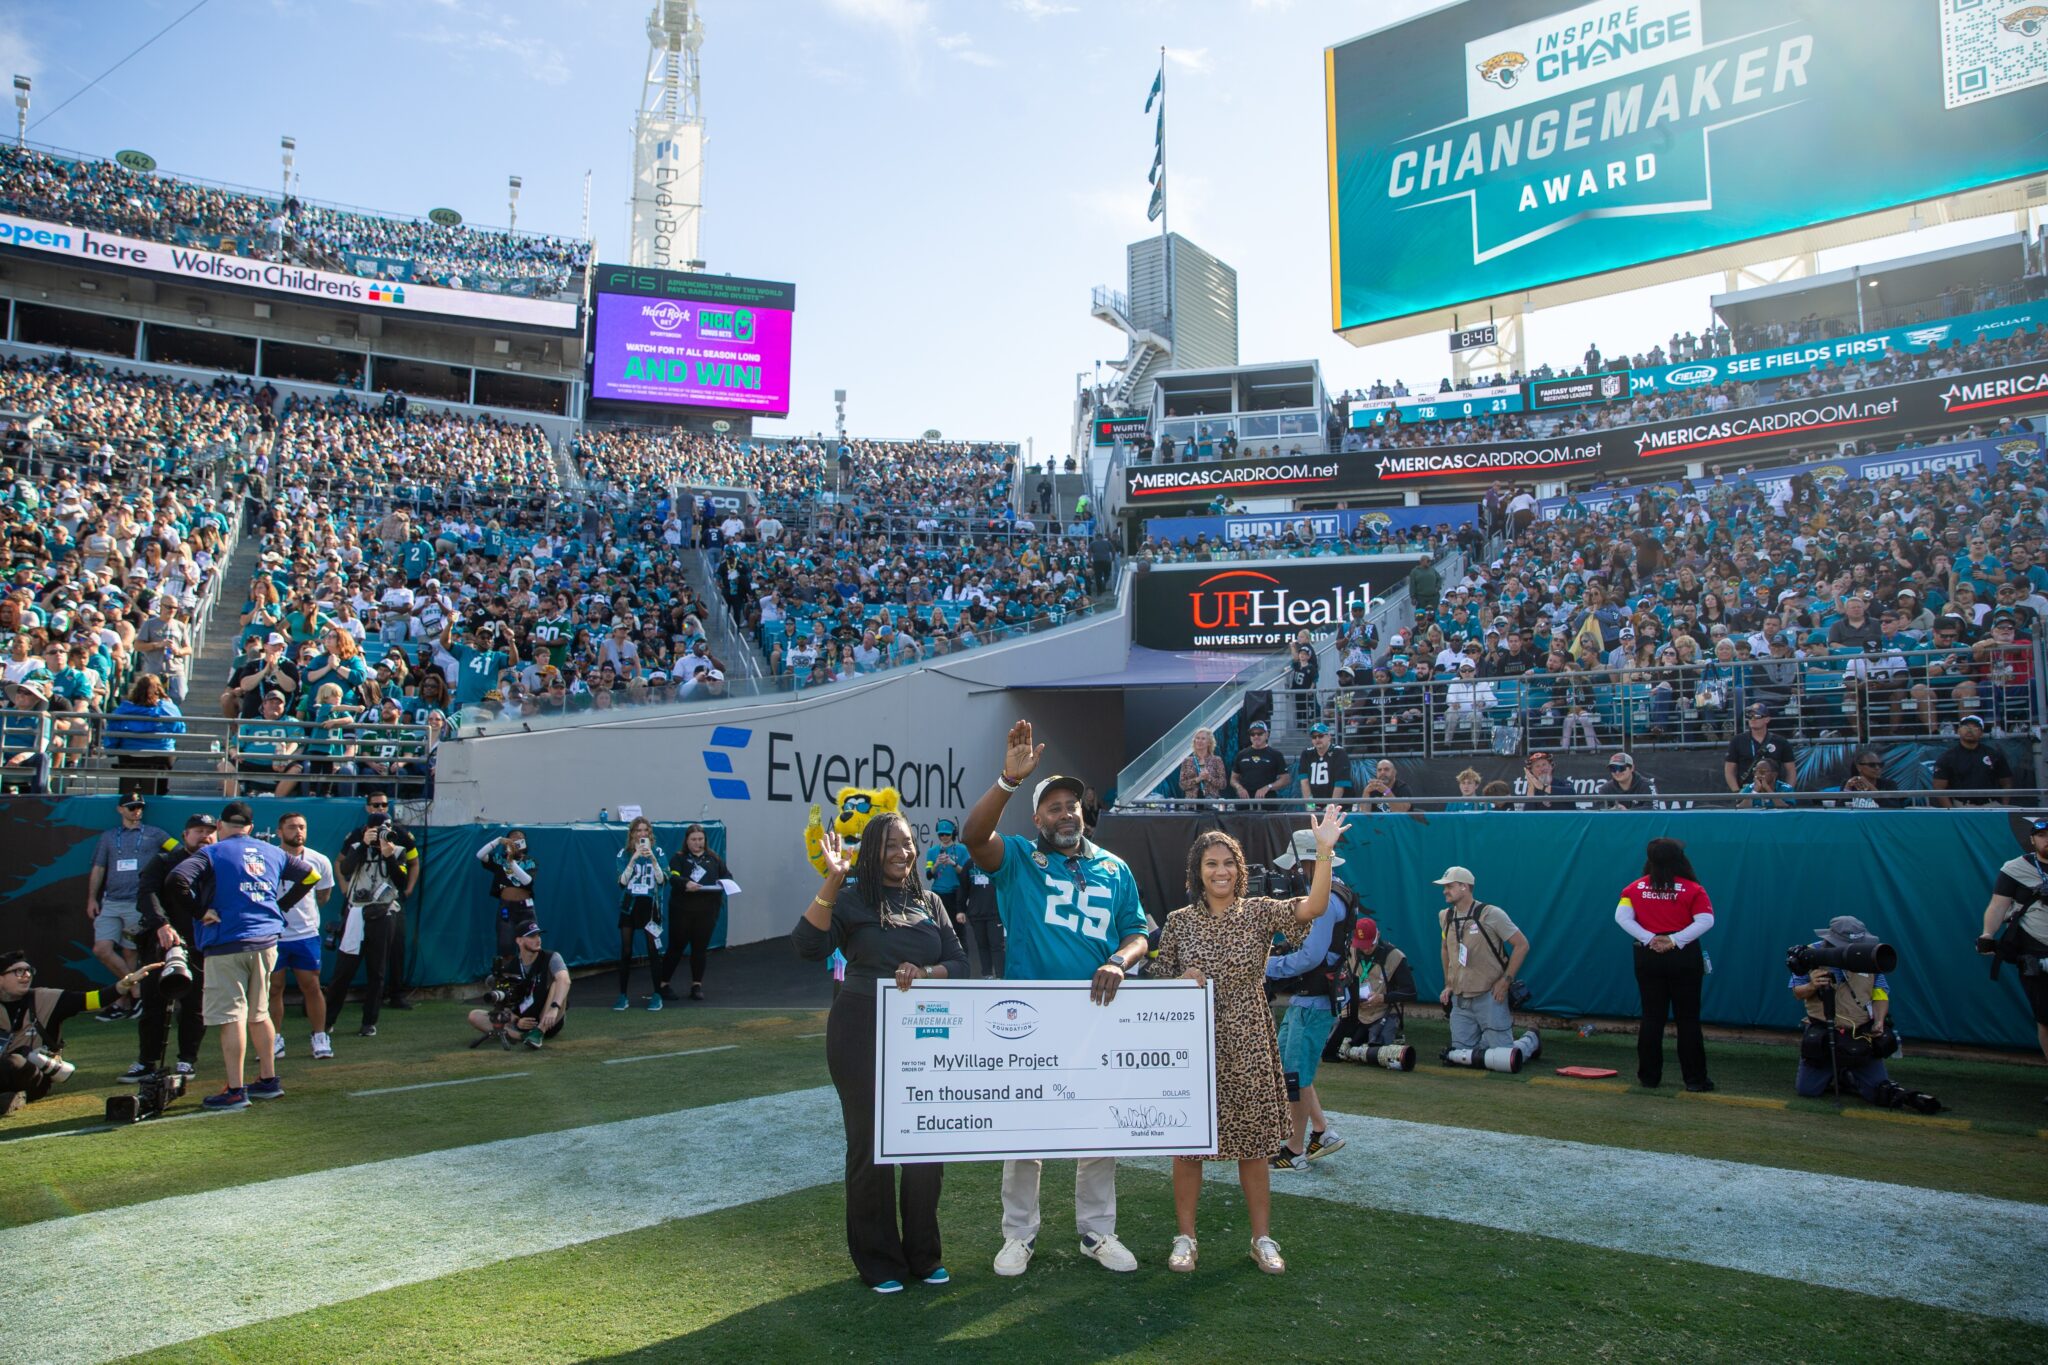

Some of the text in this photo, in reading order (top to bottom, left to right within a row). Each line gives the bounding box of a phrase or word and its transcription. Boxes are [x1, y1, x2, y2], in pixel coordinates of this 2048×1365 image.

[1536, 6, 1639, 53] INSPIRE
[1537, 10, 1692, 82] CHANGE
[1388, 34, 1814, 199] CHANGEMAKER
[124, 154, 149, 168] 442
[1518, 152, 1657, 212] AWARD
[654, 168, 678, 269] EverBan
[0, 223, 71, 248] open
[83, 232, 147, 263] here
[171, 250, 259, 282] Wolfson
[264, 267, 361, 298] Children's
[724, 284, 742, 292] WAY
[757, 287, 783, 297] WORLD
[641, 306, 690, 322] Hard Rock
[700, 311, 733, 329] PICK
[1972, 316, 2031, 332] JAGUAR
[1461, 327, 1494, 347] 8:46
[626, 343, 760, 362] WATCH FOR IT ALL SEASON LONG
[1727, 336, 1891, 375] SEE FIELDS FIRST
[624, 356, 762, 390] AND WIN!
[1674, 370, 1709, 382] FIELDS
[1540, 384, 1593, 397] FANTASY UPDATE
[1463, 403, 1472, 414] 0
[1865, 453, 1977, 480] BUD LIGHT
[492, 534, 501, 545] 12
[411, 547, 420, 561] 2
[1194, 634, 1262, 646] UNIVERSITY
[1265, 633, 1281, 644] OF
[469, 656, 491, 675] 41
[768, 731, 966, 809] EverBank
[1310, 762, 1329, 785] 16
[1045, 875, 1112, 942] 25
[902, 1017, 963, 1026] CHANGEMAKER
[1137, 1012, 1195, 1021] 12/14/2025
[992, 1024, 1032, 1032] FOUNDATION
[934, 1054, 1059, 1071] MyVillage Project
[906, 1086, 933, 1101] Ten
[939, 1085, 1010, 1101] thousand
[1015, 1085, 1043, 1099] and
[917, 1115, 993, 1131] Education
